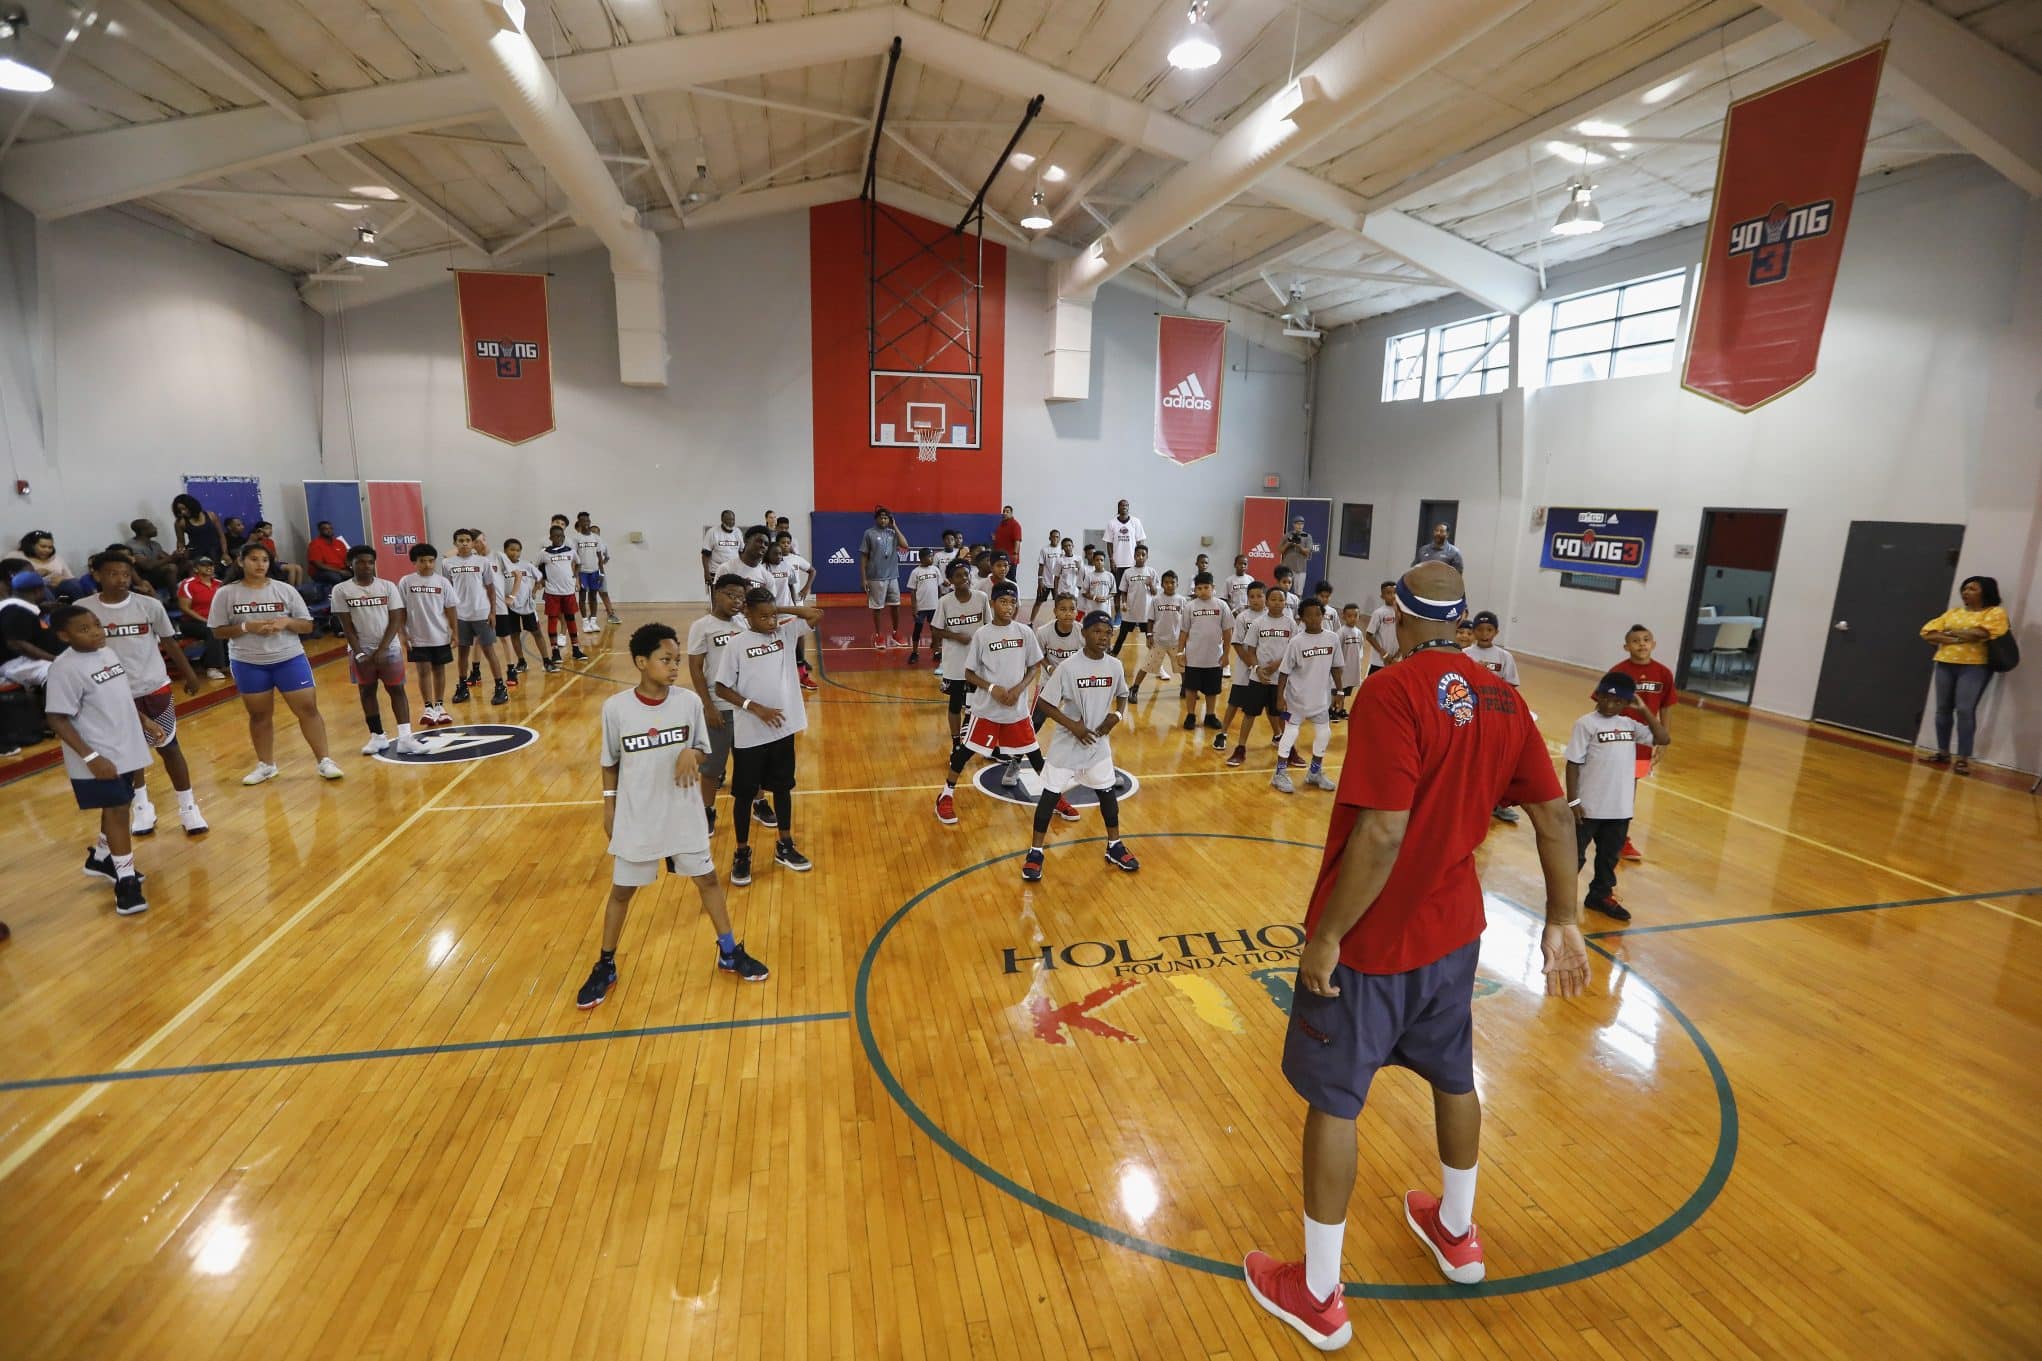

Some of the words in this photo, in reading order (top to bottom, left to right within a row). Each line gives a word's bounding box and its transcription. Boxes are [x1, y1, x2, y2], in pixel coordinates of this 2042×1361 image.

[1755, 245, 1785, 280] 3
[1163, 395, 1212, 410] adidas
[1248, 551, 1275, 559] adidas
[985, 735, 994, 747] 7
[1002, 922, 1306, 975] HOLTHO
[1114, 948, 1303, 977] FOUNDATION
